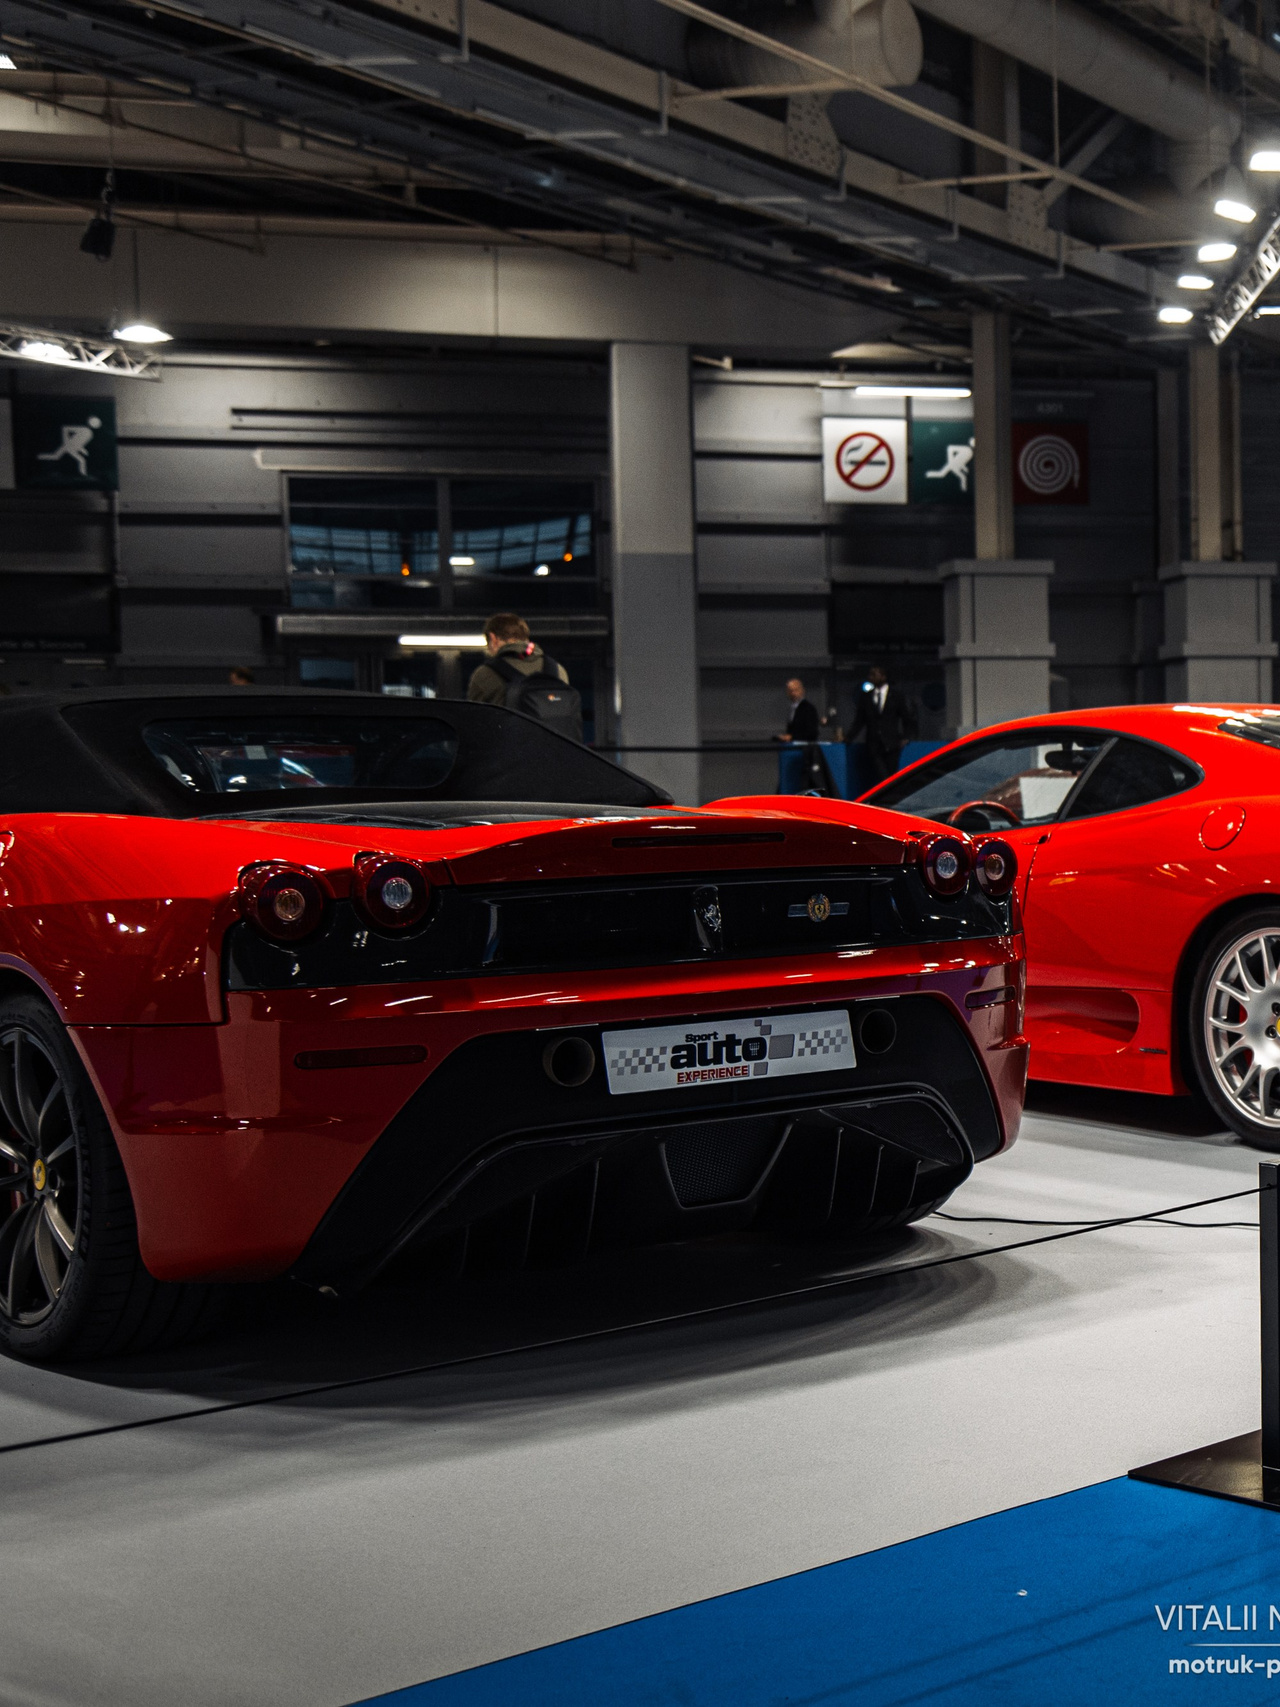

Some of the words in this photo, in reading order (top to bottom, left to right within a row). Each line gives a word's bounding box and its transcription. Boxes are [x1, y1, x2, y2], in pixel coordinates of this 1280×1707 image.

[685, 1031, 718, 1043] Sport
[670, 1033, 768, 1070] auto
[677, 1065, 749, 1084] EXPERIENCE
[77, 1125, 92, 1254] MICHELIN
